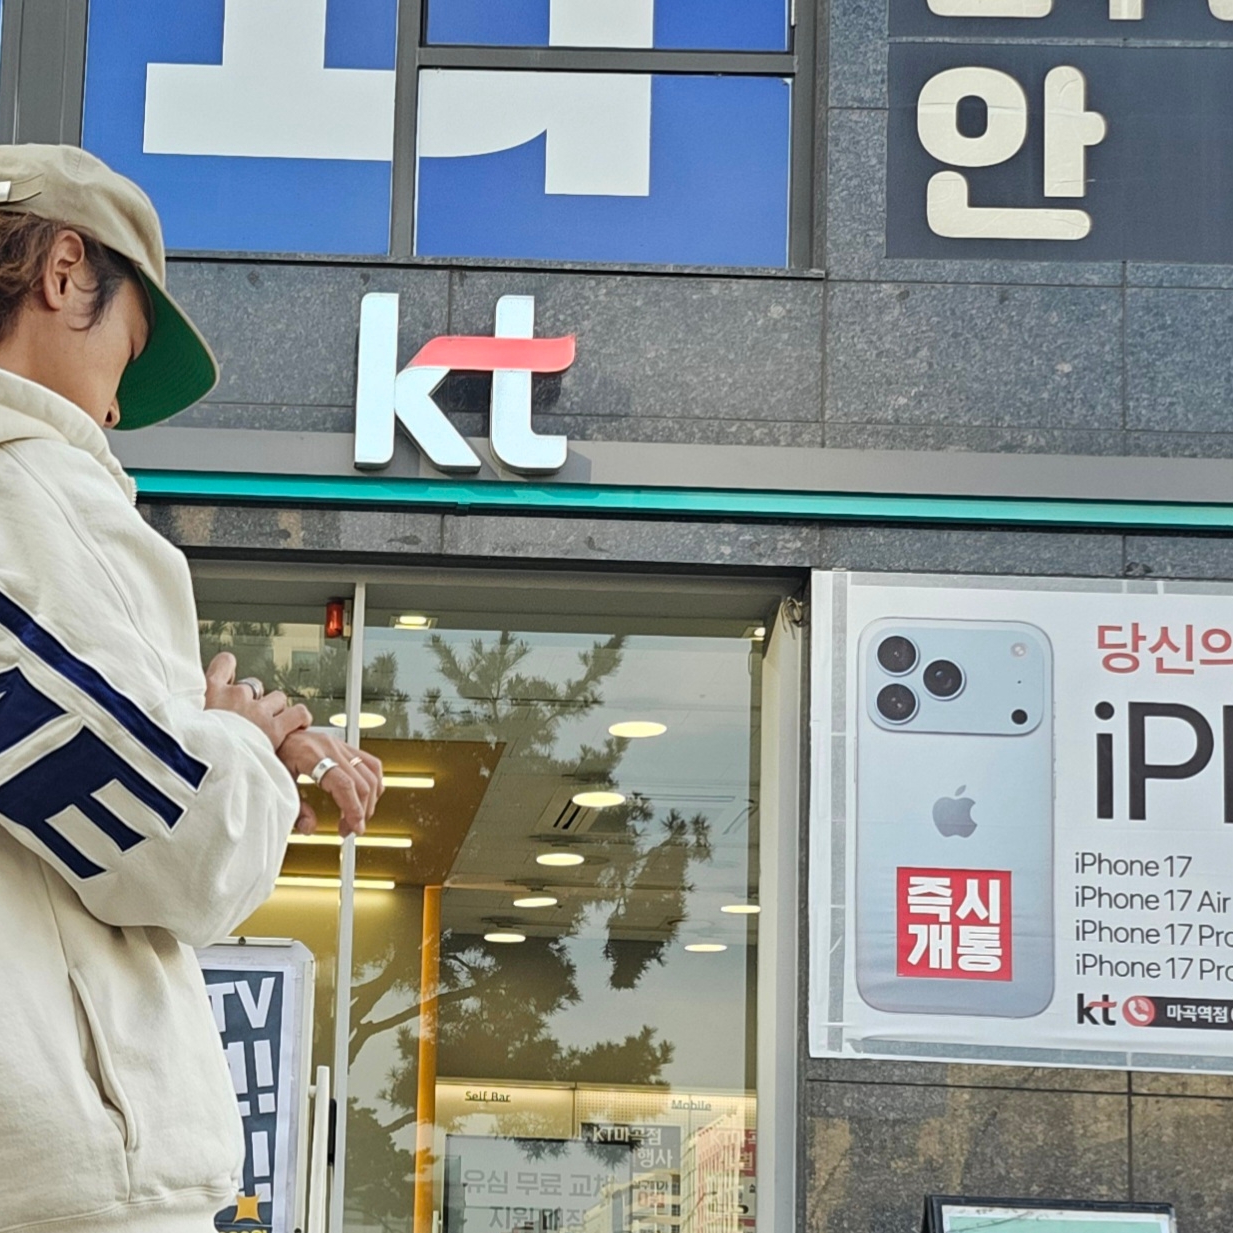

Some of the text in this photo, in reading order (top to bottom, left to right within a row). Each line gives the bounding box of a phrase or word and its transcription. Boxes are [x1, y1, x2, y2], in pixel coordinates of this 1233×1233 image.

[917, 65, 1106, 240] 안
[353, 291, 577, 475] kt
[1094, 700, 1233, 824] iP
[1075, 851, 1193, 878] iPhone 17
[907, 875, 1001, 925] 즉시
[1075, 885, 1232, 914] iPhone 17 Air
[907, 924, 1003, 973] 개통
[1075, 919, 1161, 945] iPhone
[1164, 922, 1194, 946] 17
[1076, 953, 1162, 979] iPhone
[1165, 957, 1194, 980] 17
[1076, 992, 1228, 1027] kt 마곡역점
[464, 1168, 510, 1195] 유심
[515, 1171, 563, 1197] 무료
